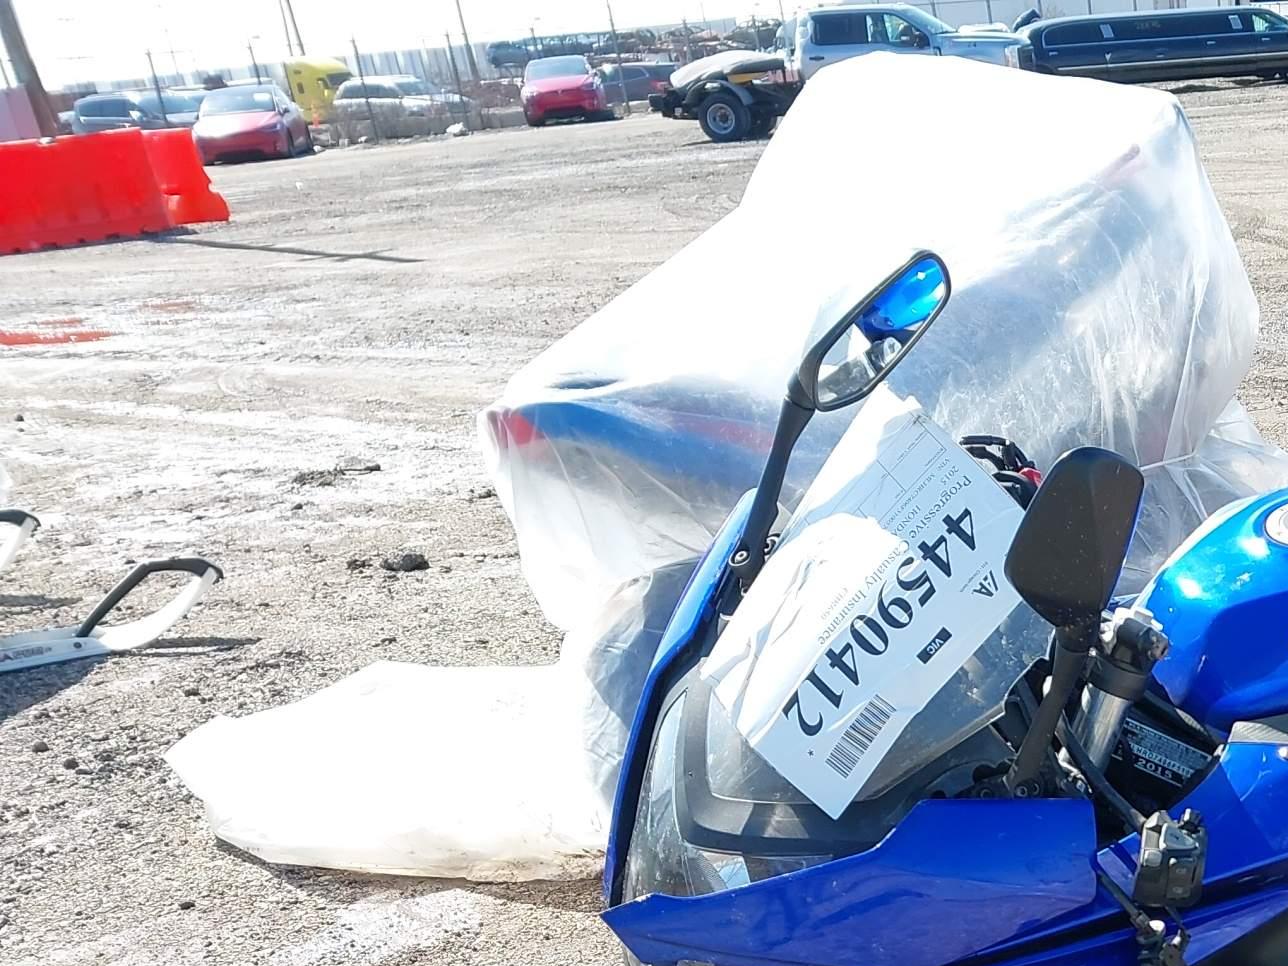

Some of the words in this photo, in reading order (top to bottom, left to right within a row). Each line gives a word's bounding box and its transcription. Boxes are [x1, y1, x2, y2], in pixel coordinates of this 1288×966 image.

[939, 464, 960, 485] 2015
[891, 504, 921, 537] HONDA
[906, 473, 972, 544] Progressive
[863, 535, 913, 590] Casualty
[782, 507, 976, 737] 44590412
[817, 589, 867, 645] Insurance
[926, 637, 944, 656] VIC
[1137, 758, 1173, 779] 2015
